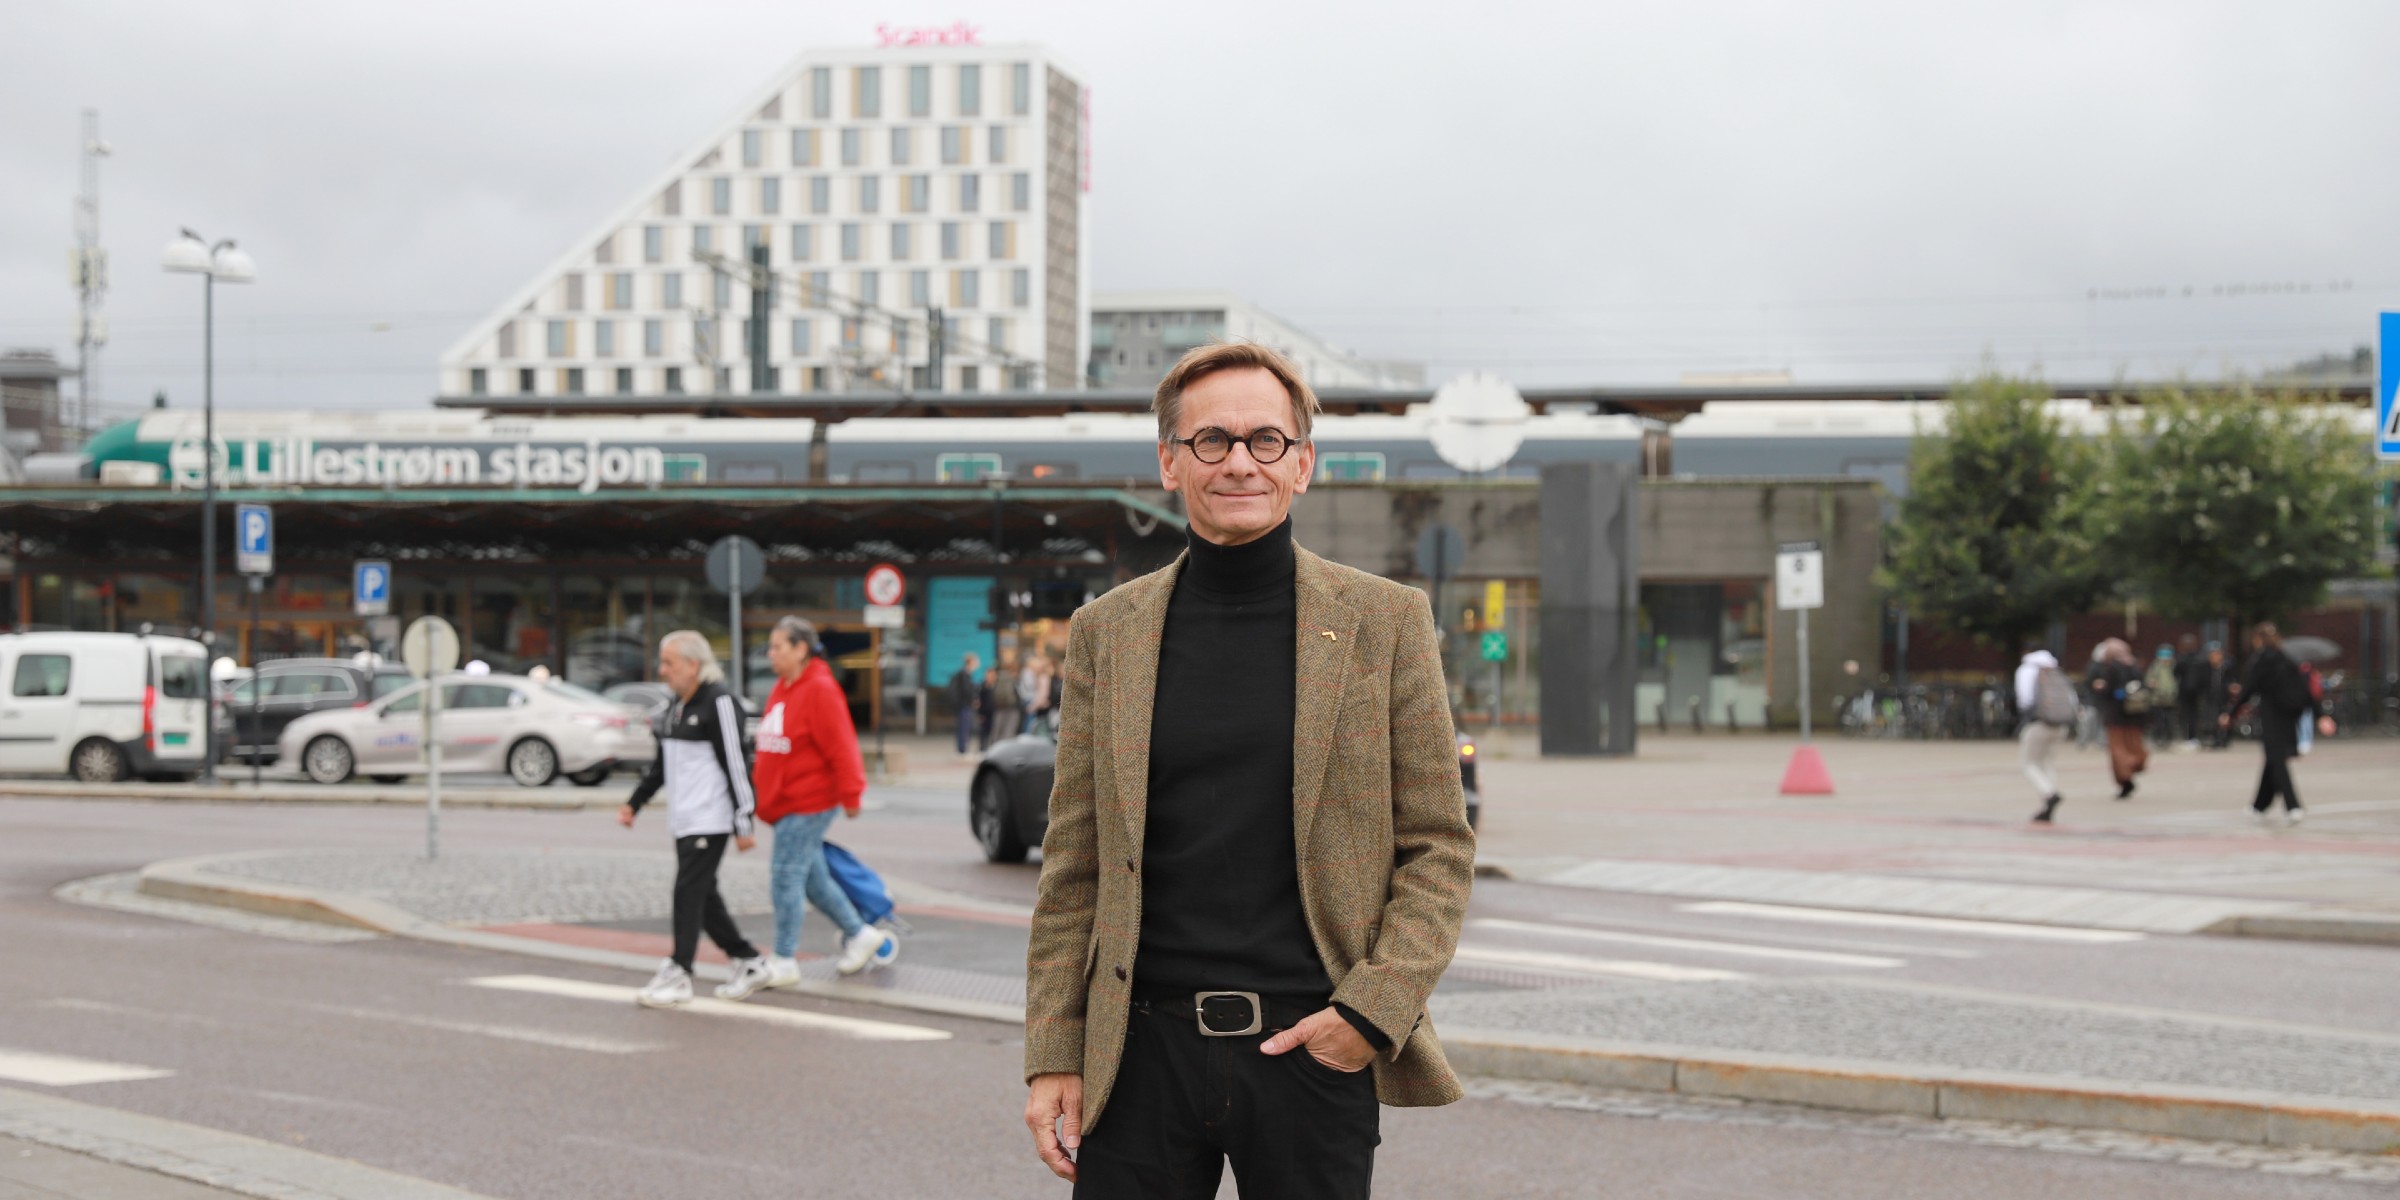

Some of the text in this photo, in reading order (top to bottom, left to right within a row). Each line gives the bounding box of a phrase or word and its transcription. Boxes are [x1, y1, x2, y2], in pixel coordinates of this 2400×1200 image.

[875, 20, 983, 46] Scandic
[243, 435, 665, 494] Lillestrøm stasjon
[246, 513, 266, 551] P
[363, 567, 384, 599] P
